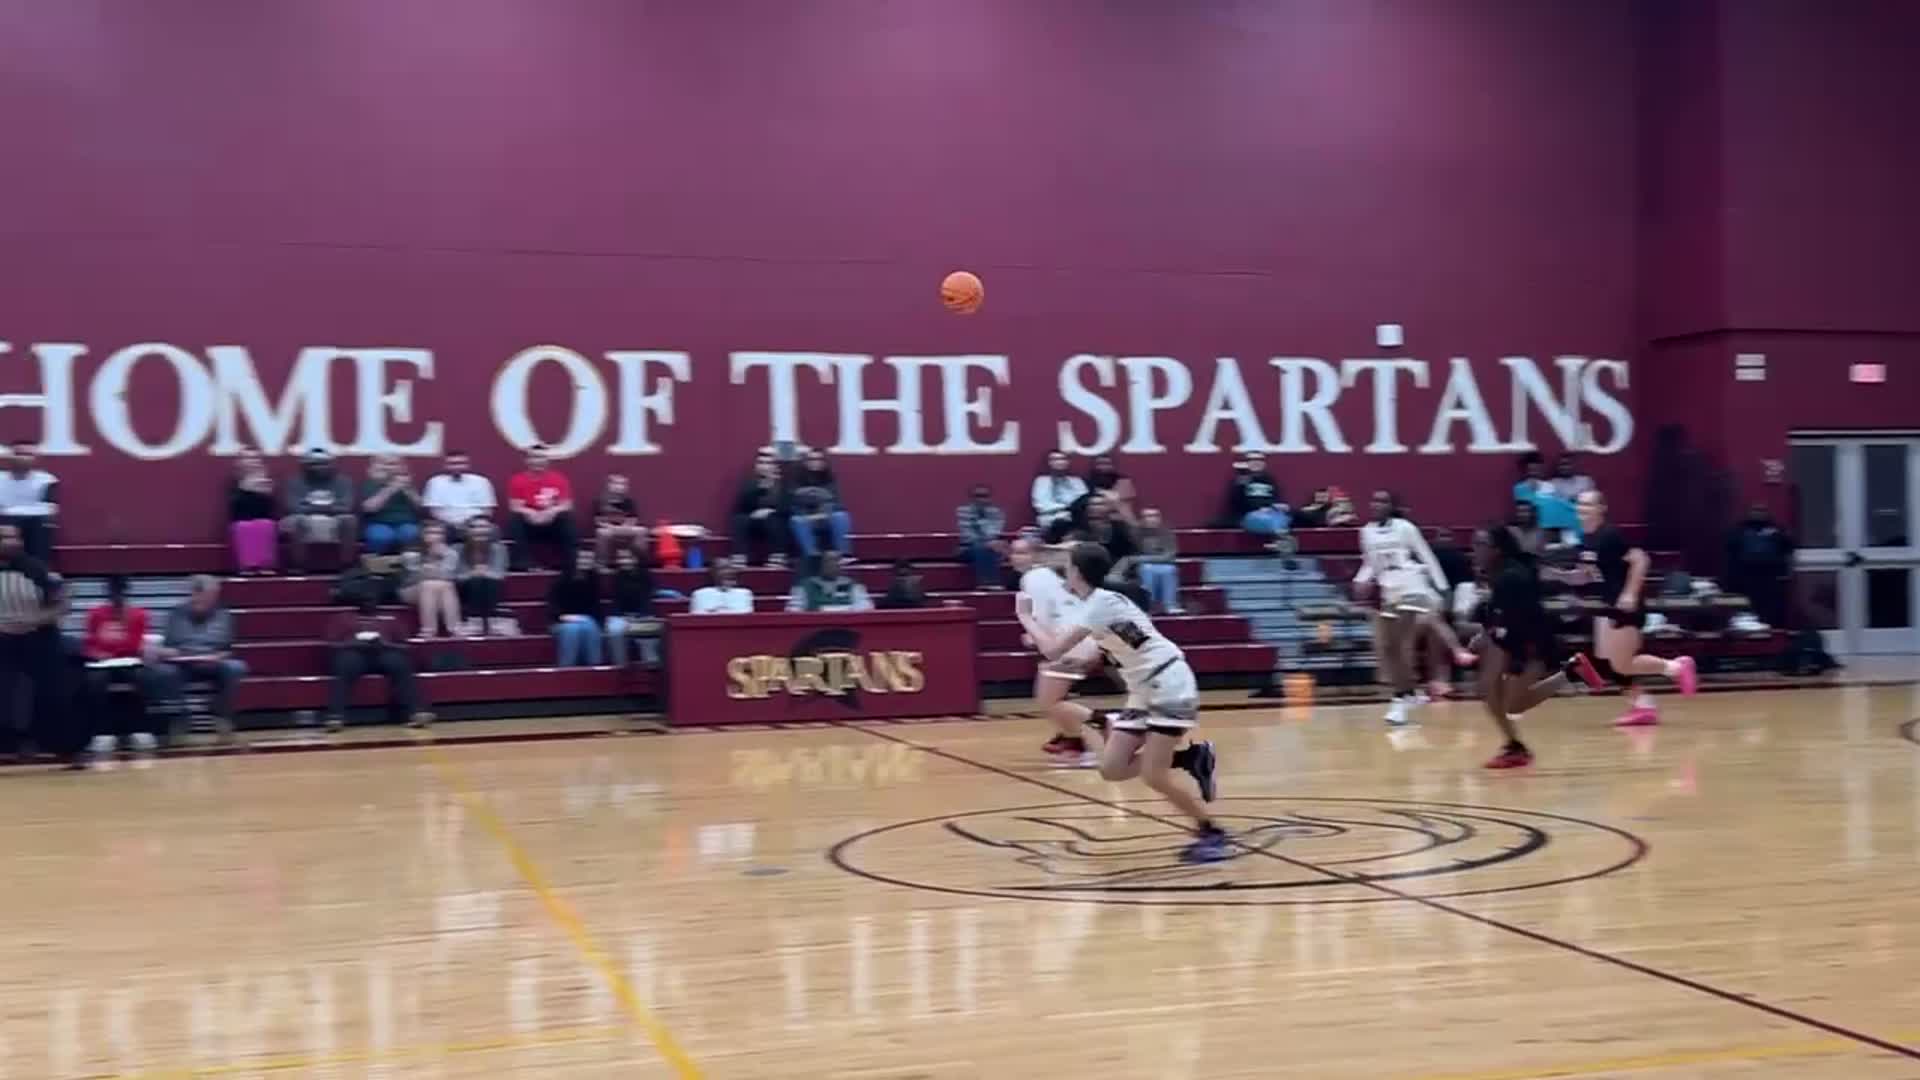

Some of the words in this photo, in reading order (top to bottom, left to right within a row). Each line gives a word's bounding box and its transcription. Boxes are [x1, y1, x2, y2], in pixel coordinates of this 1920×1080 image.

[0, 342, 443, 460] HOME
[490, 345, 692, 459] OF
[729, 351, 1020, 455] THE
[1058, 353, 1635, 455] SPARTANS
[726, 651, 925, 699] SPARTANS
